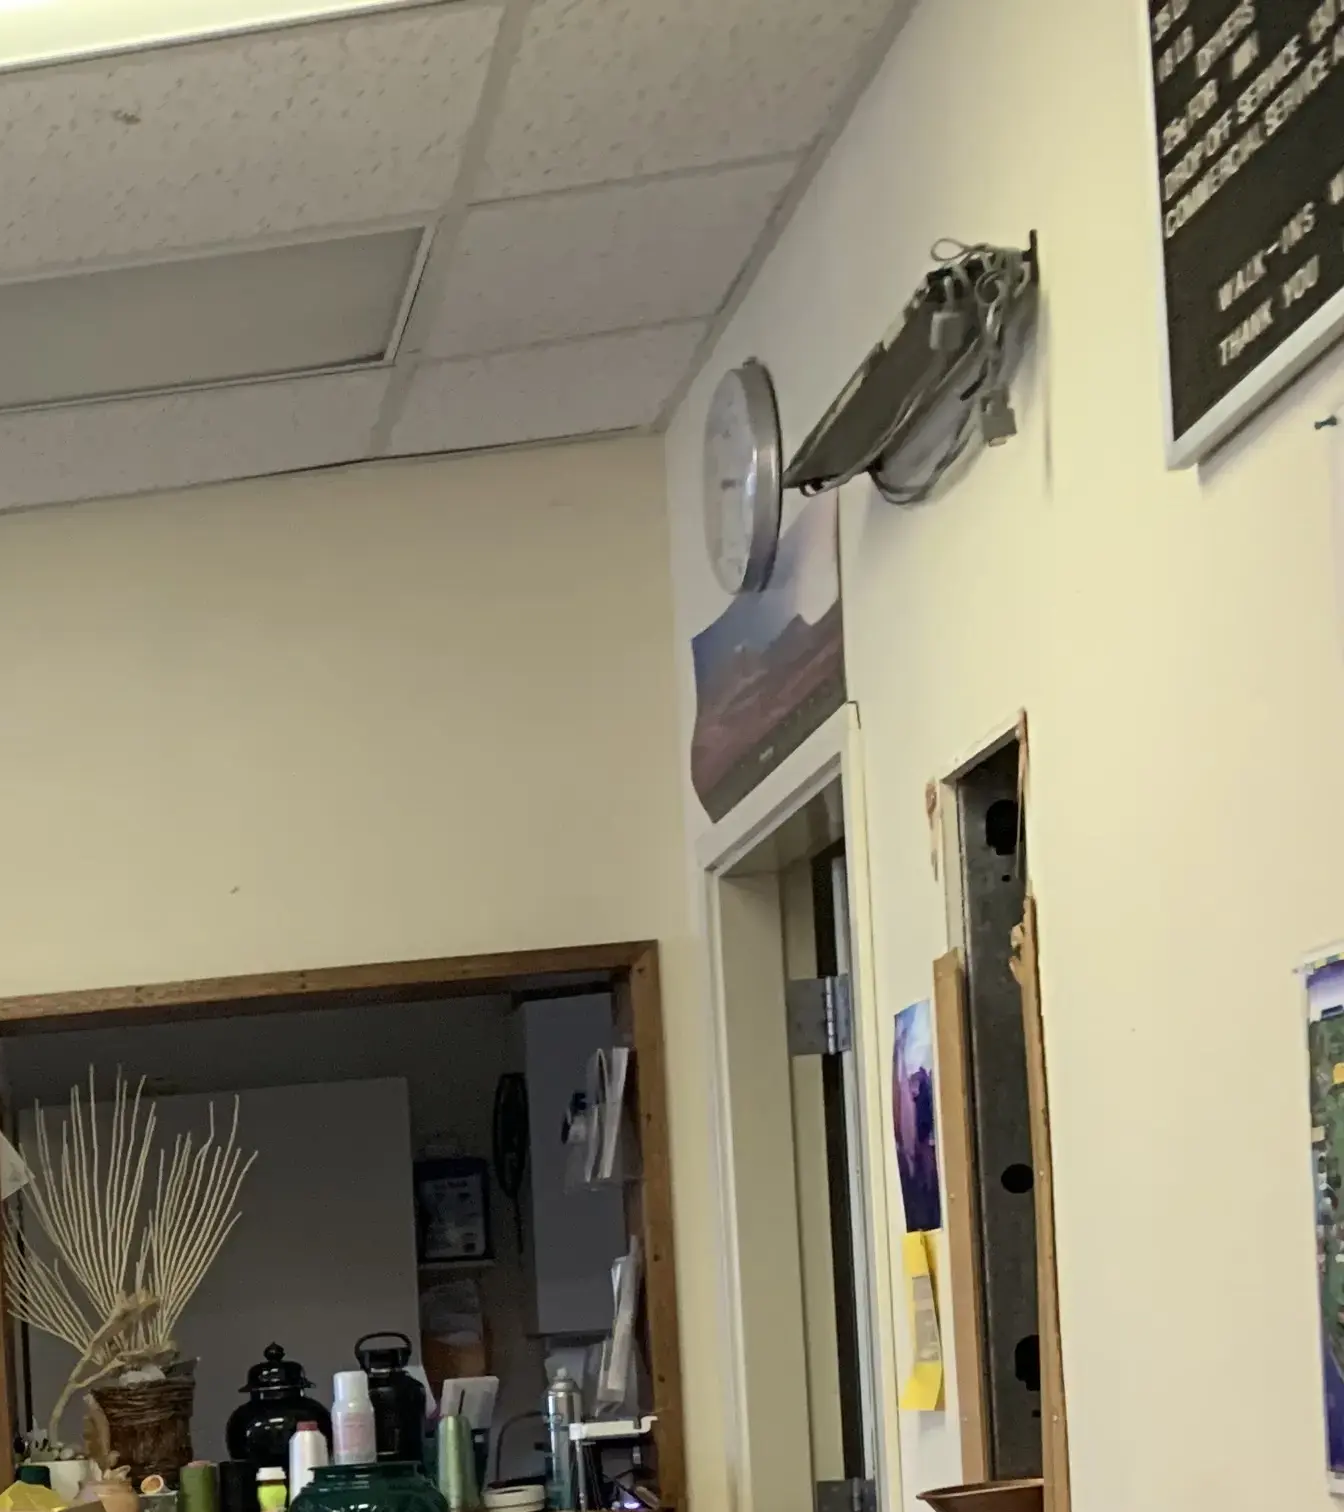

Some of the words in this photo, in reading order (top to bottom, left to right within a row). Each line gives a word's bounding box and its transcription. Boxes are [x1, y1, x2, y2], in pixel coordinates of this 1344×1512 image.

[1237, 33, 1302, 125] SERVICE
[1165, 121, 1266, 238] COMMERCIAL
[1264, 47, 1330, 137] SERVICE
[1219, 298, 1275, 366] THANK
[1281, 254, 1320, 310] YOU
